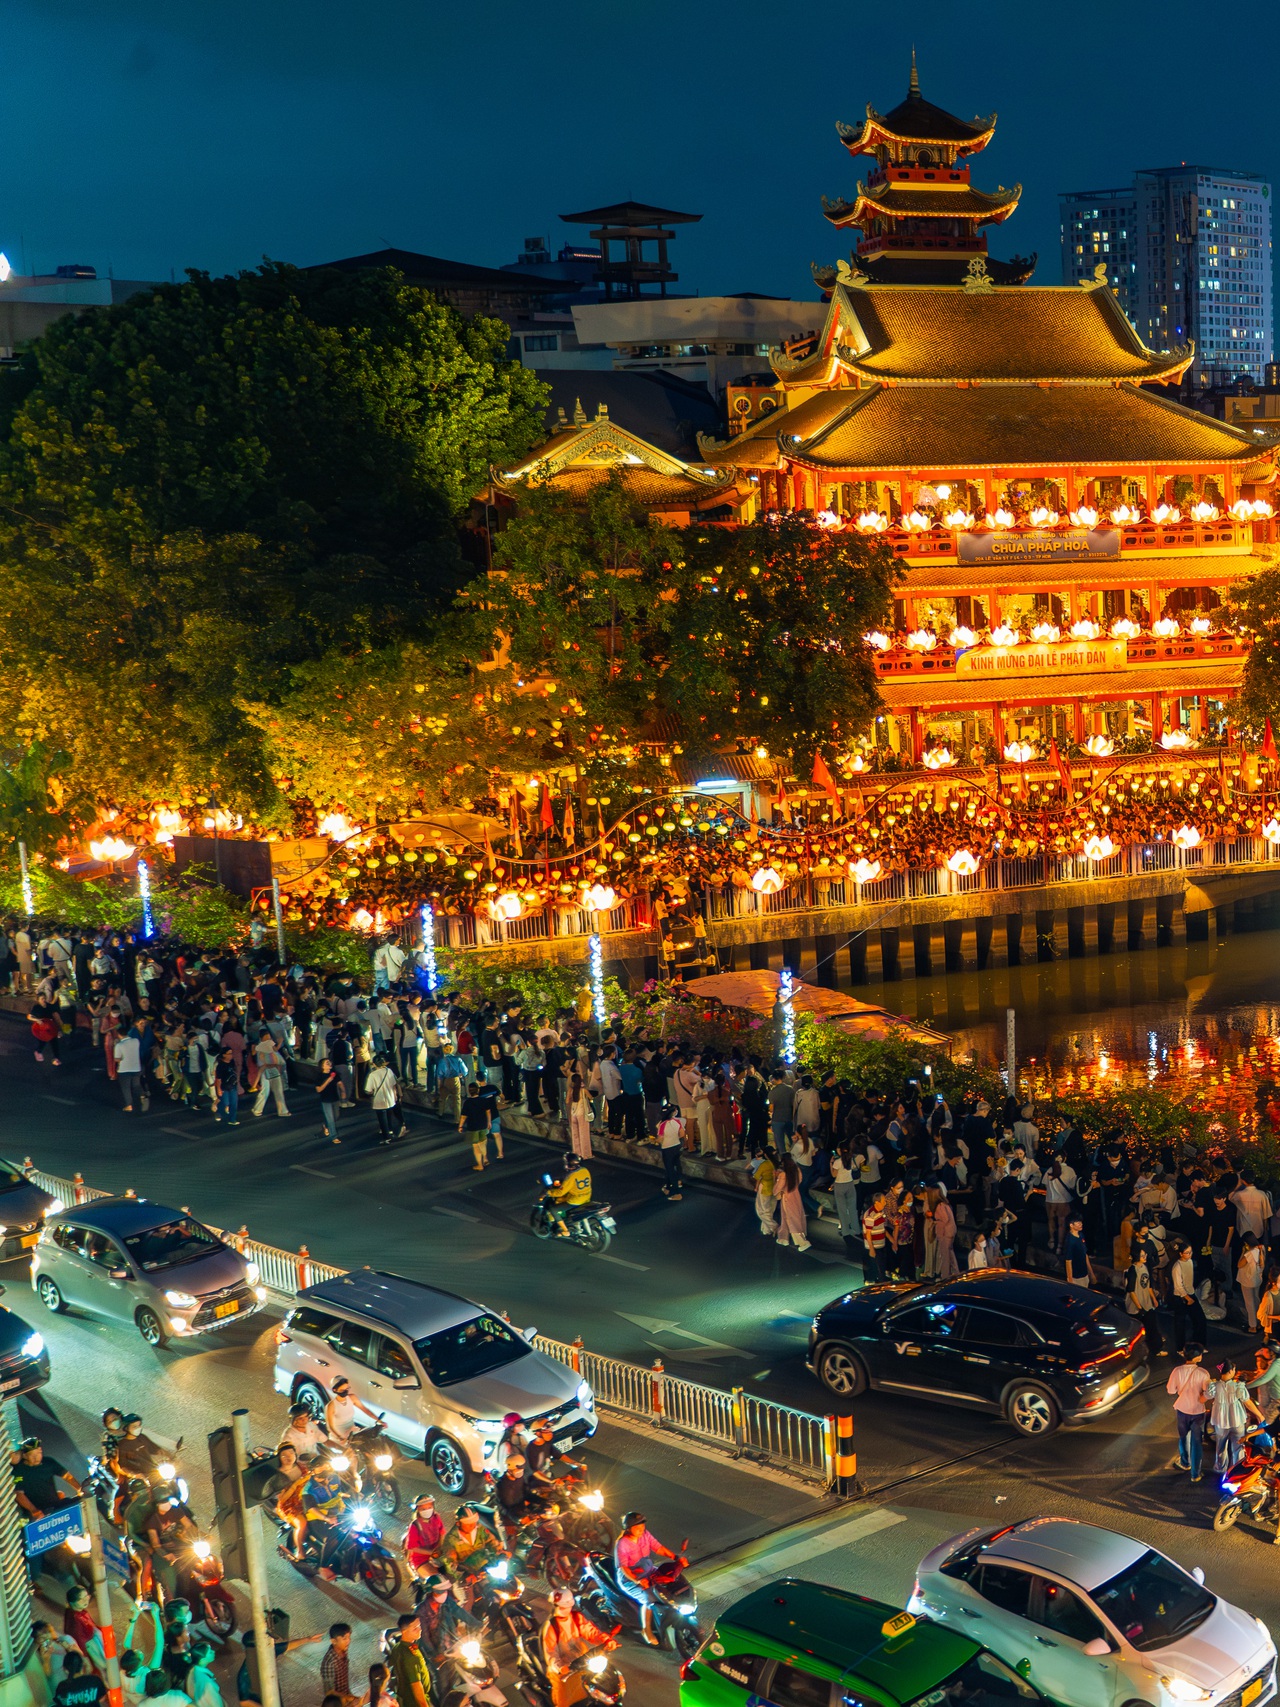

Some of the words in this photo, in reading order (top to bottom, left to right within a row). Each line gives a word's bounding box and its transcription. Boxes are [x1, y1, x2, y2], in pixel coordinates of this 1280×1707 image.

[992, 539, 1025, 553] CHÙA
[1028, 538, 1062, 553] PHÁP
[1063, 540, 1090, 551] HOA
[996, 653, 1025, 669] MỪNG
[1028, 653, 1044, 670] ĐẠI
[37, 1513, 71, 1532] ĐƯỜNG
[67, 1524, 80, 1536] SA
